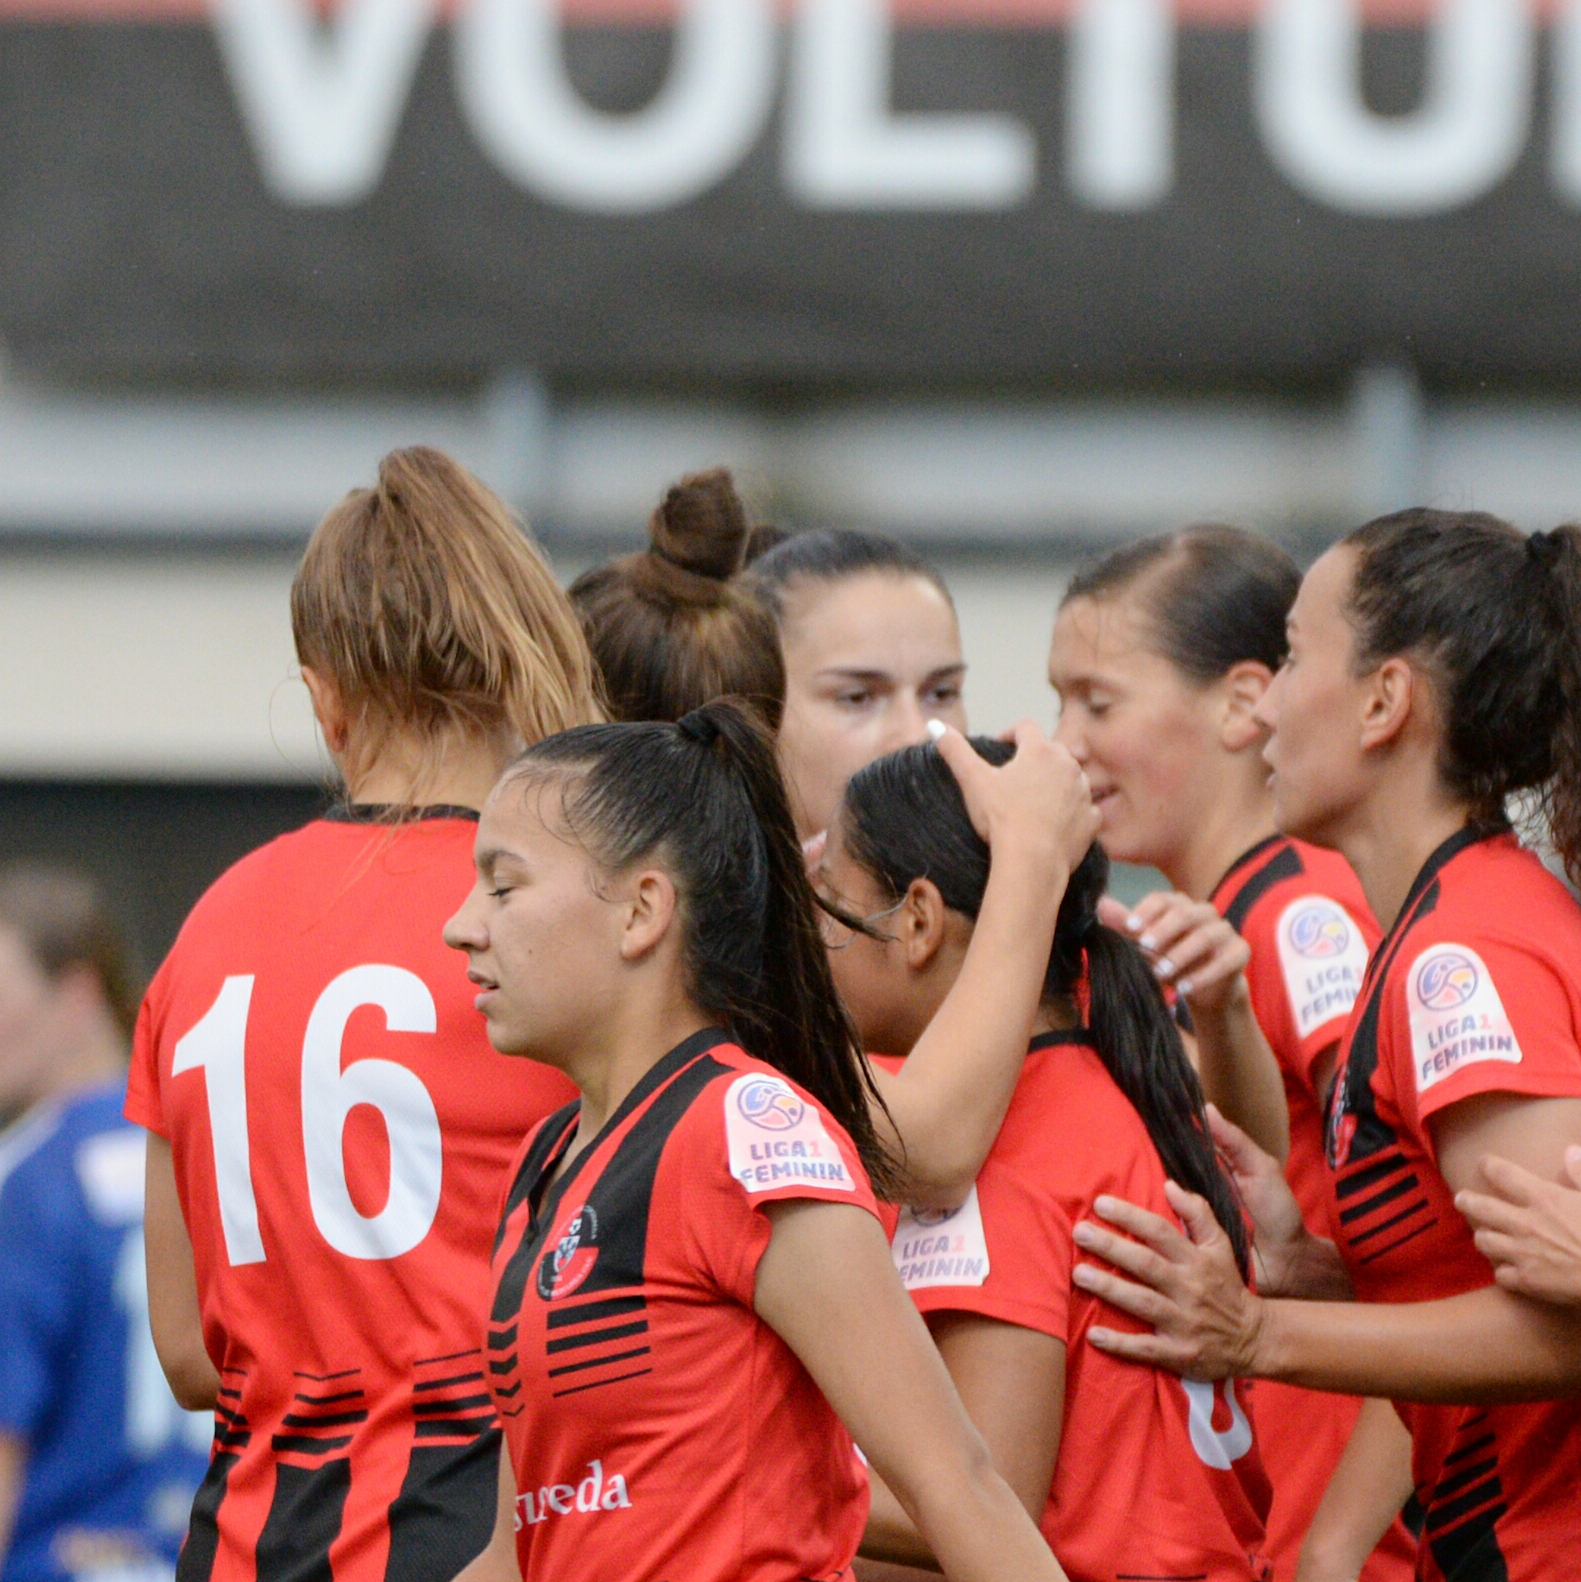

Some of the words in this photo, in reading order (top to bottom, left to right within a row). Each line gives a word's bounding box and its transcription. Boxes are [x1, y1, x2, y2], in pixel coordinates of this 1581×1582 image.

[1422, 1034, 1514, 1082] FEMININ
[172, 963, 443, 1267] 16
[739, 1161, 845, 1184] FEMININ
